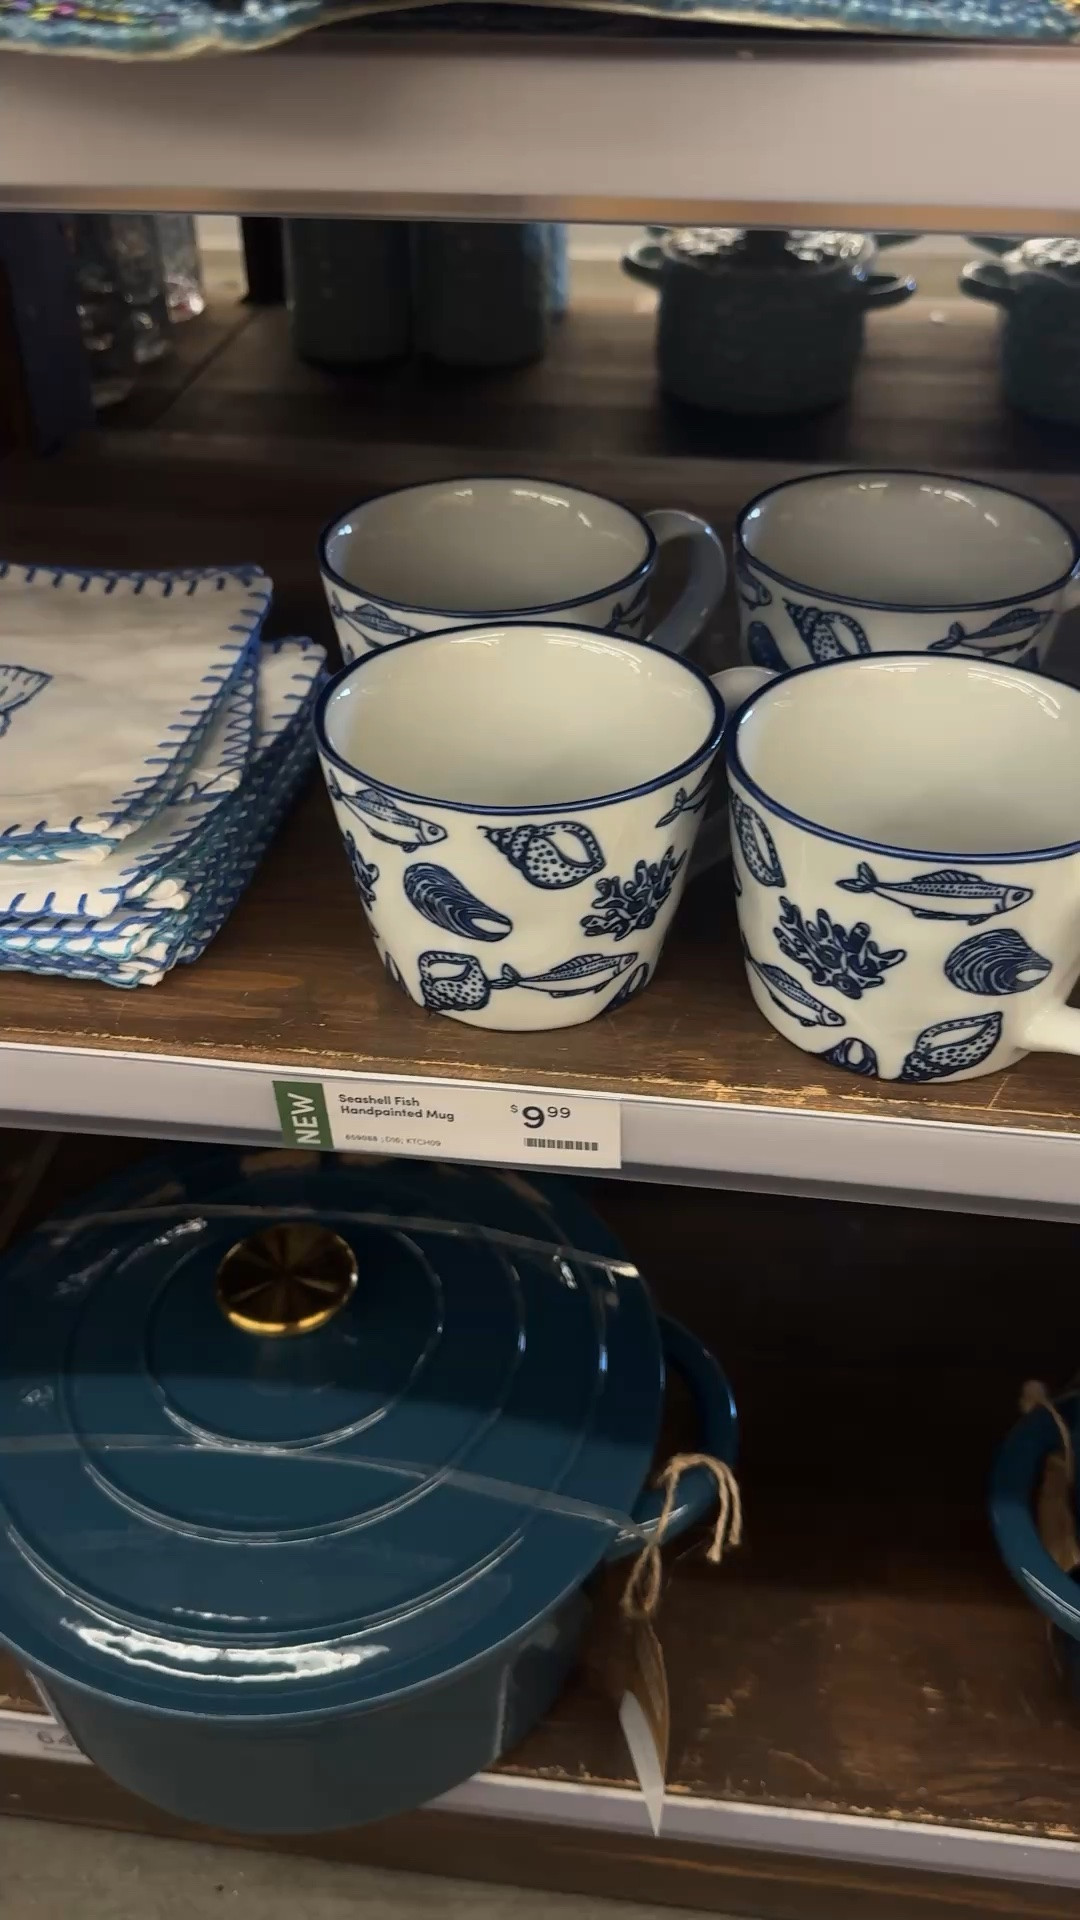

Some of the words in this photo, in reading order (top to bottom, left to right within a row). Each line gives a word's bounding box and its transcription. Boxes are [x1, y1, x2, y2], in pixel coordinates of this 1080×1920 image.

[338, 1094, 391, 1105] Seashell
[395, 1096, 420, 1107] Fish
[287, 1092, 322, 1145] NEW
[341, 1105, 423, 1118] Handpainted
[426, 1110, 455, 1122] Mug
